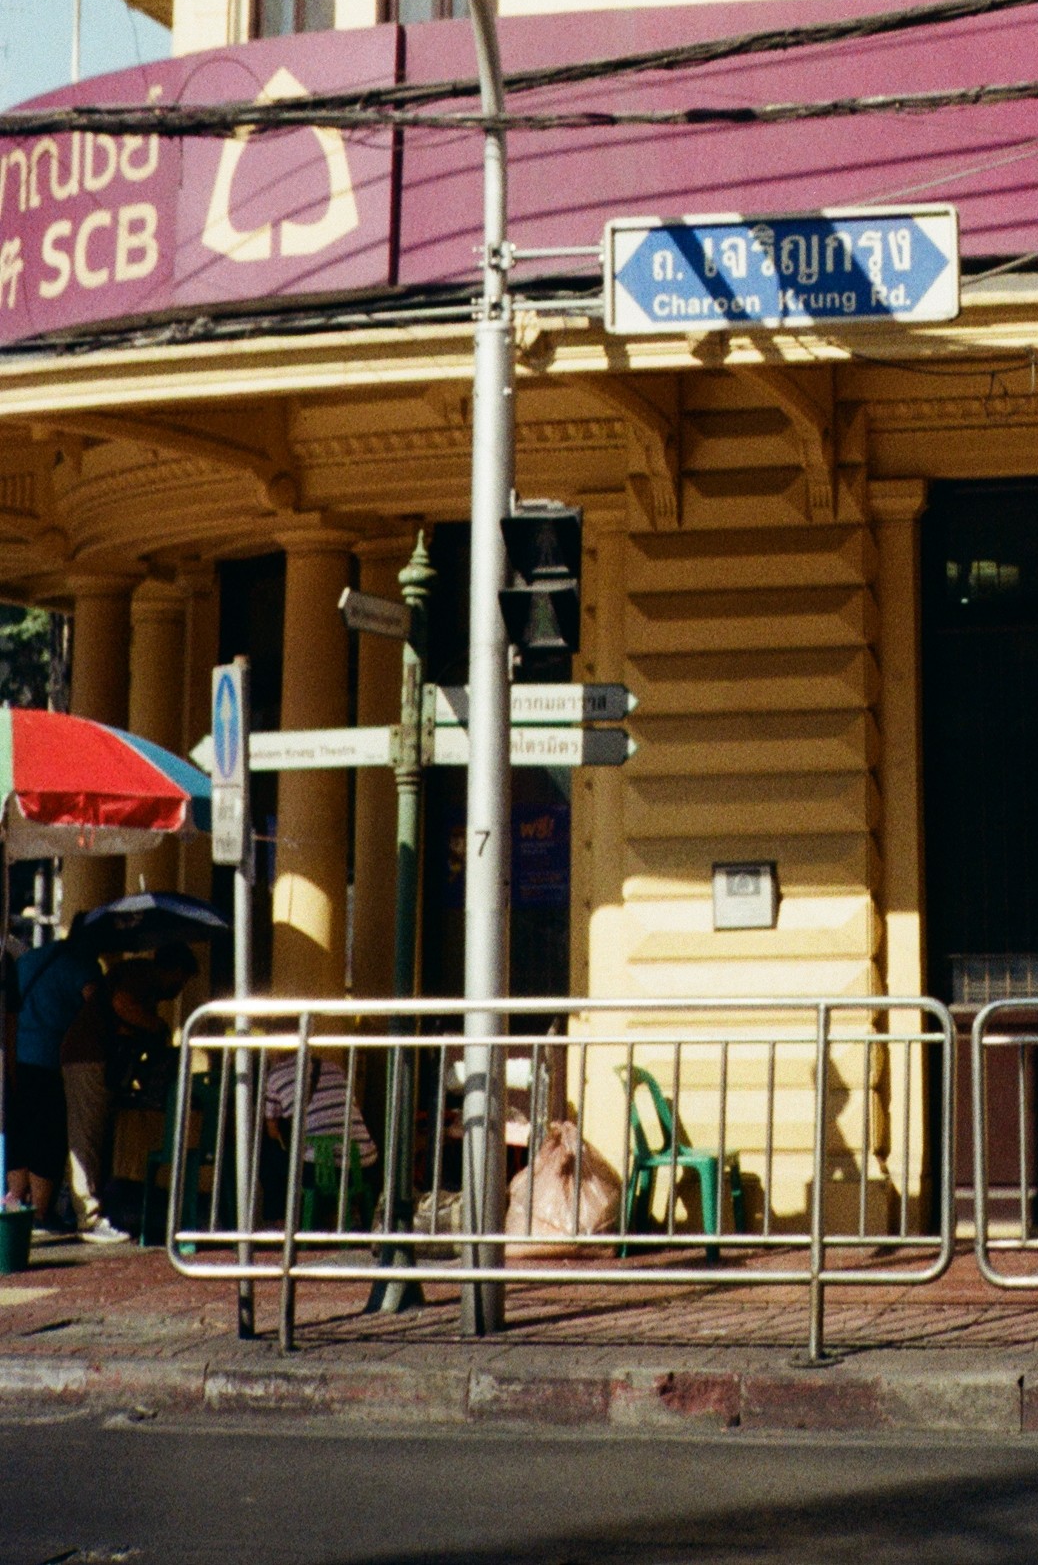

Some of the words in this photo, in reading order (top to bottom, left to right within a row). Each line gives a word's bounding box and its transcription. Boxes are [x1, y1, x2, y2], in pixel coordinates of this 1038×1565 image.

[39, 202, 159, 299] SCB
[652, 249, 684, 282] ถ.
[704, 224, 911, 285] เจริญกรุง
[654, 292, 760, 316] Charoen
[778, 287, 857, 314] Krung
[872, 285, 911, 309] Rd.
[475, 831, 490, 857] 7
